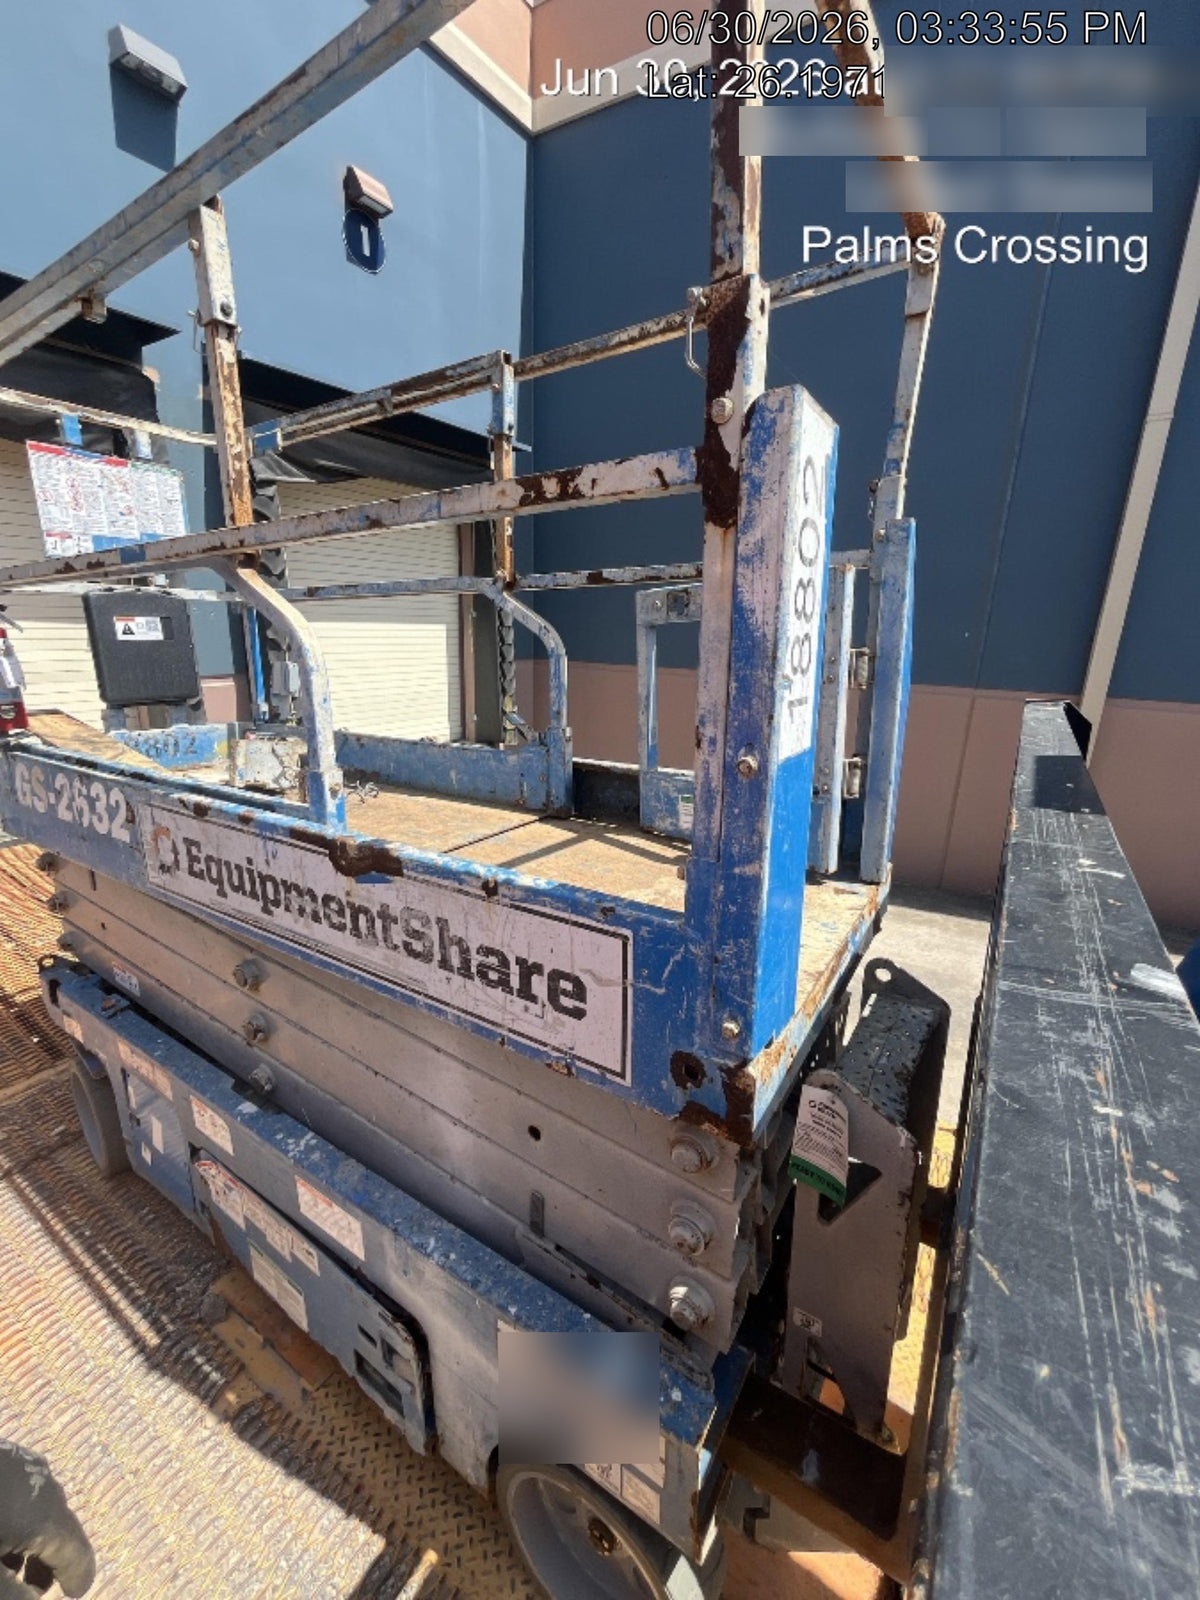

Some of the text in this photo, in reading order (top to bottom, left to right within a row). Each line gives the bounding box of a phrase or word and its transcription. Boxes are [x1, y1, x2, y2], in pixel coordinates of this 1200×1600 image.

[360, 223, 371, 257] 1
[786, 454, 831, 724] 18802
[15, 762, 131, 844] GS-2632
[182, 836, 589, 1022] EquipmentShare
